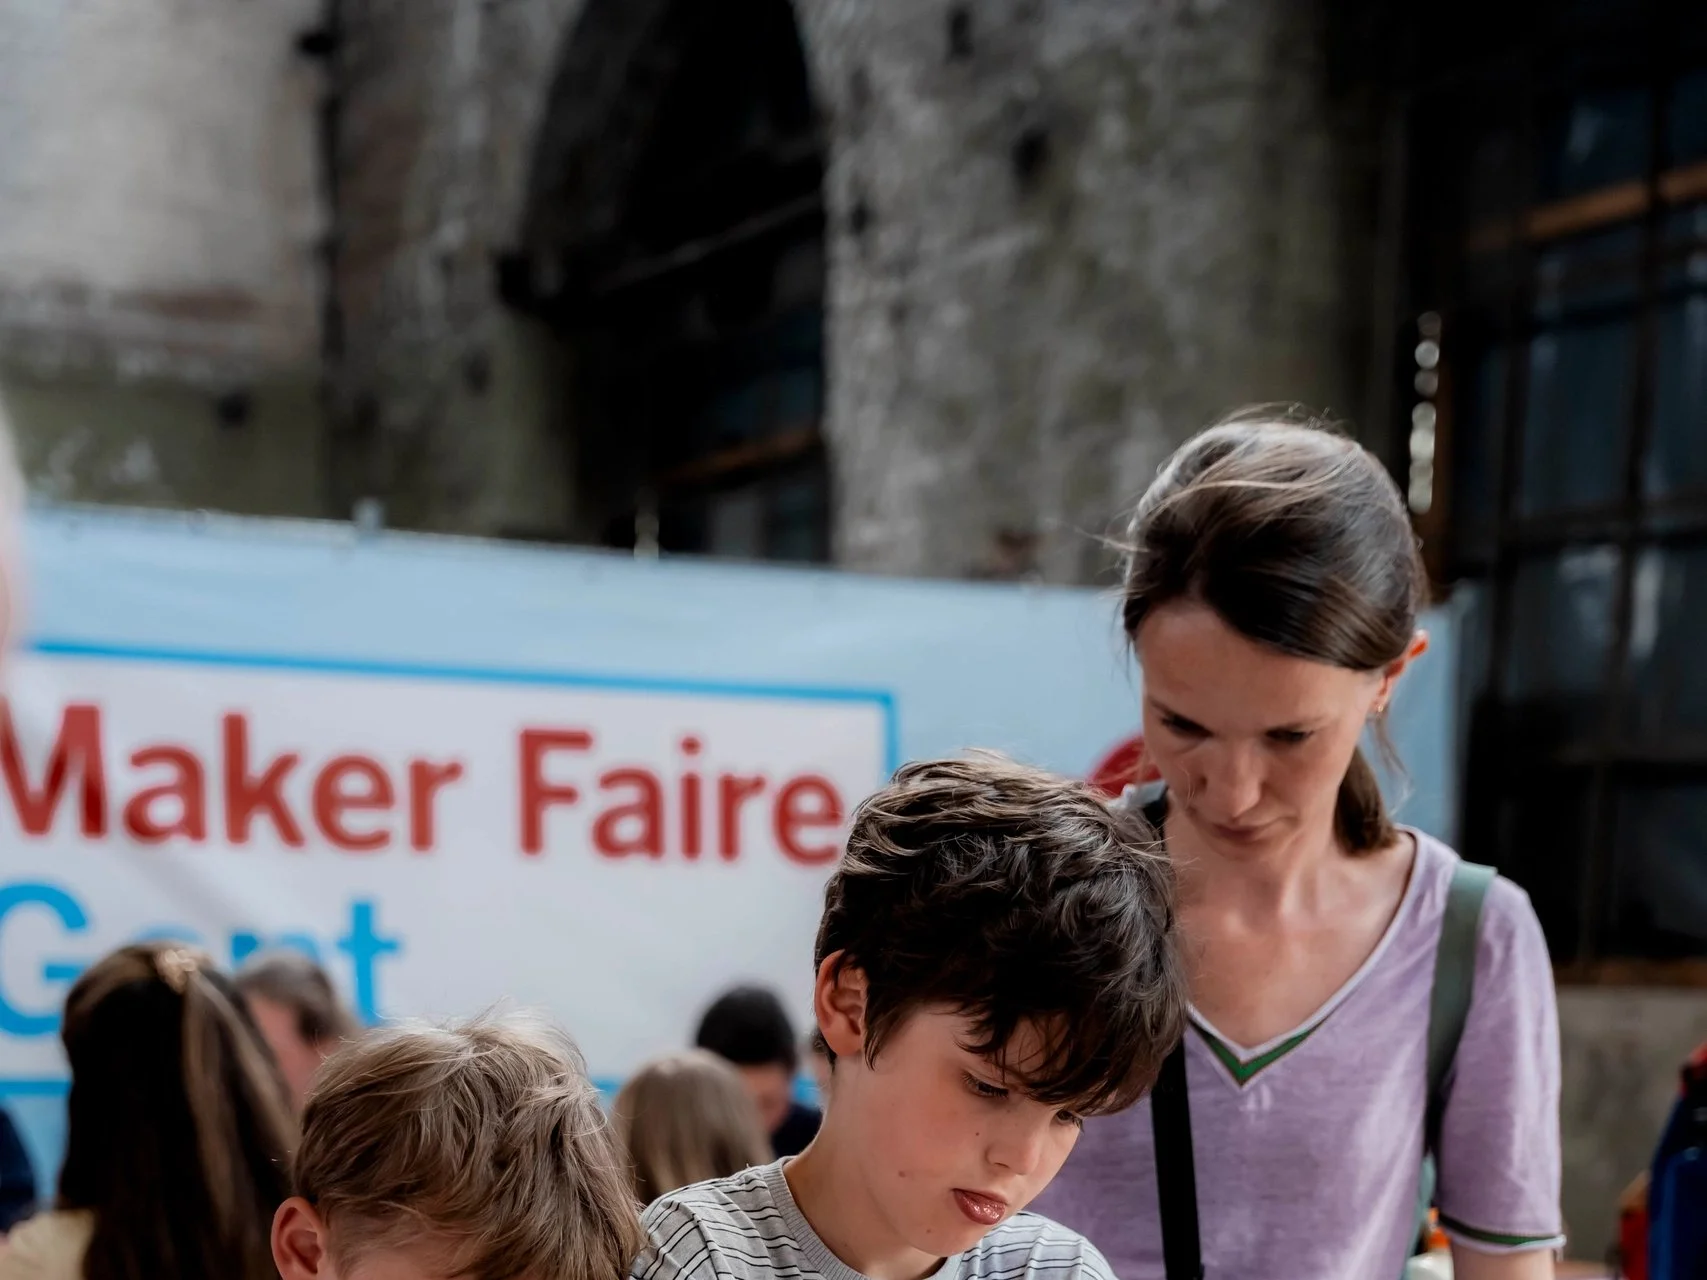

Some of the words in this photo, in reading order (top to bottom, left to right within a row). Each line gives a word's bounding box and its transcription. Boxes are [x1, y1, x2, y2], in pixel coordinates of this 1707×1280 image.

[0, 702, 464, 852] Maker
[519, 727, 845, 867] Faire
[0, 882, 402, 1037] Gt
